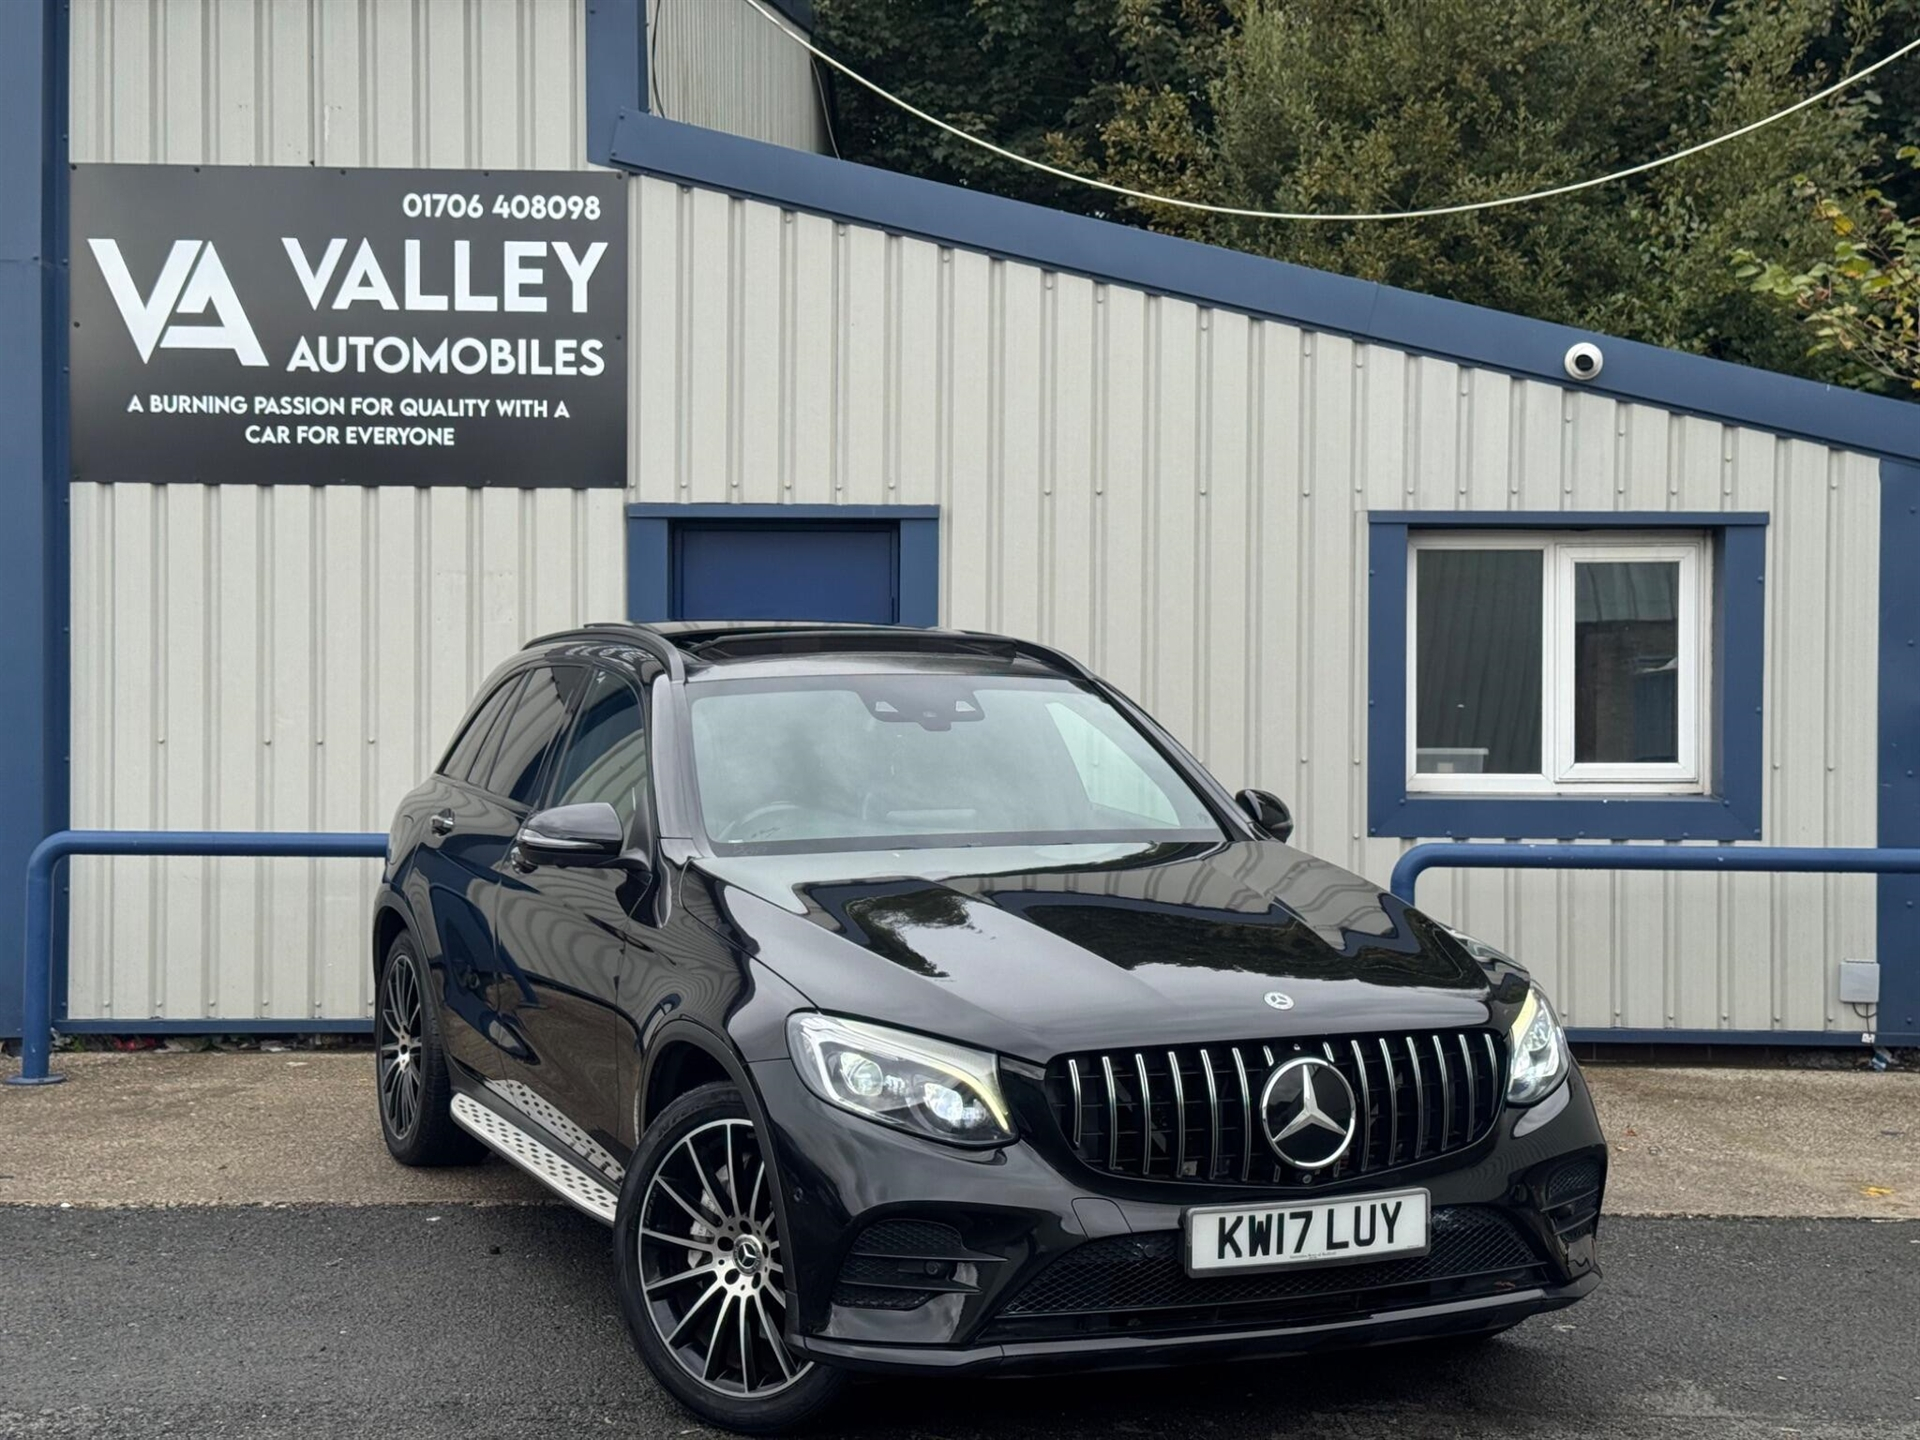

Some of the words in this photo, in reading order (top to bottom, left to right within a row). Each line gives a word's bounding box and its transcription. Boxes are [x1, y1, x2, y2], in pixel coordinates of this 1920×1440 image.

[401, 193, 484, 219] 01706
[491, 194, 602, 221] 408098
[281, 236, 609, 314] VALLEY
[86, 237, 270, 367] VA
[285, 335, 606, 377] AUTOMOBILES
[126, 394, 145, 413] A
[149, 394, 248, 415] BURNING
[254, 395, 345, 416] PASSION
[350, 397, 395, 416] FOR
[399, 398, 491, 419] QUALITY
[495, 398, 548, 418] WITH
[553, 400, 571, 419] A
[244, 424, 291, 444] CAR
[296, 425, 341, 445] FOR
[345, 426, 455, 447] EVERYONE
[1217, 1210, 1313, 1260] KW17
[1326, 1201, 1402, 1251] LUY
